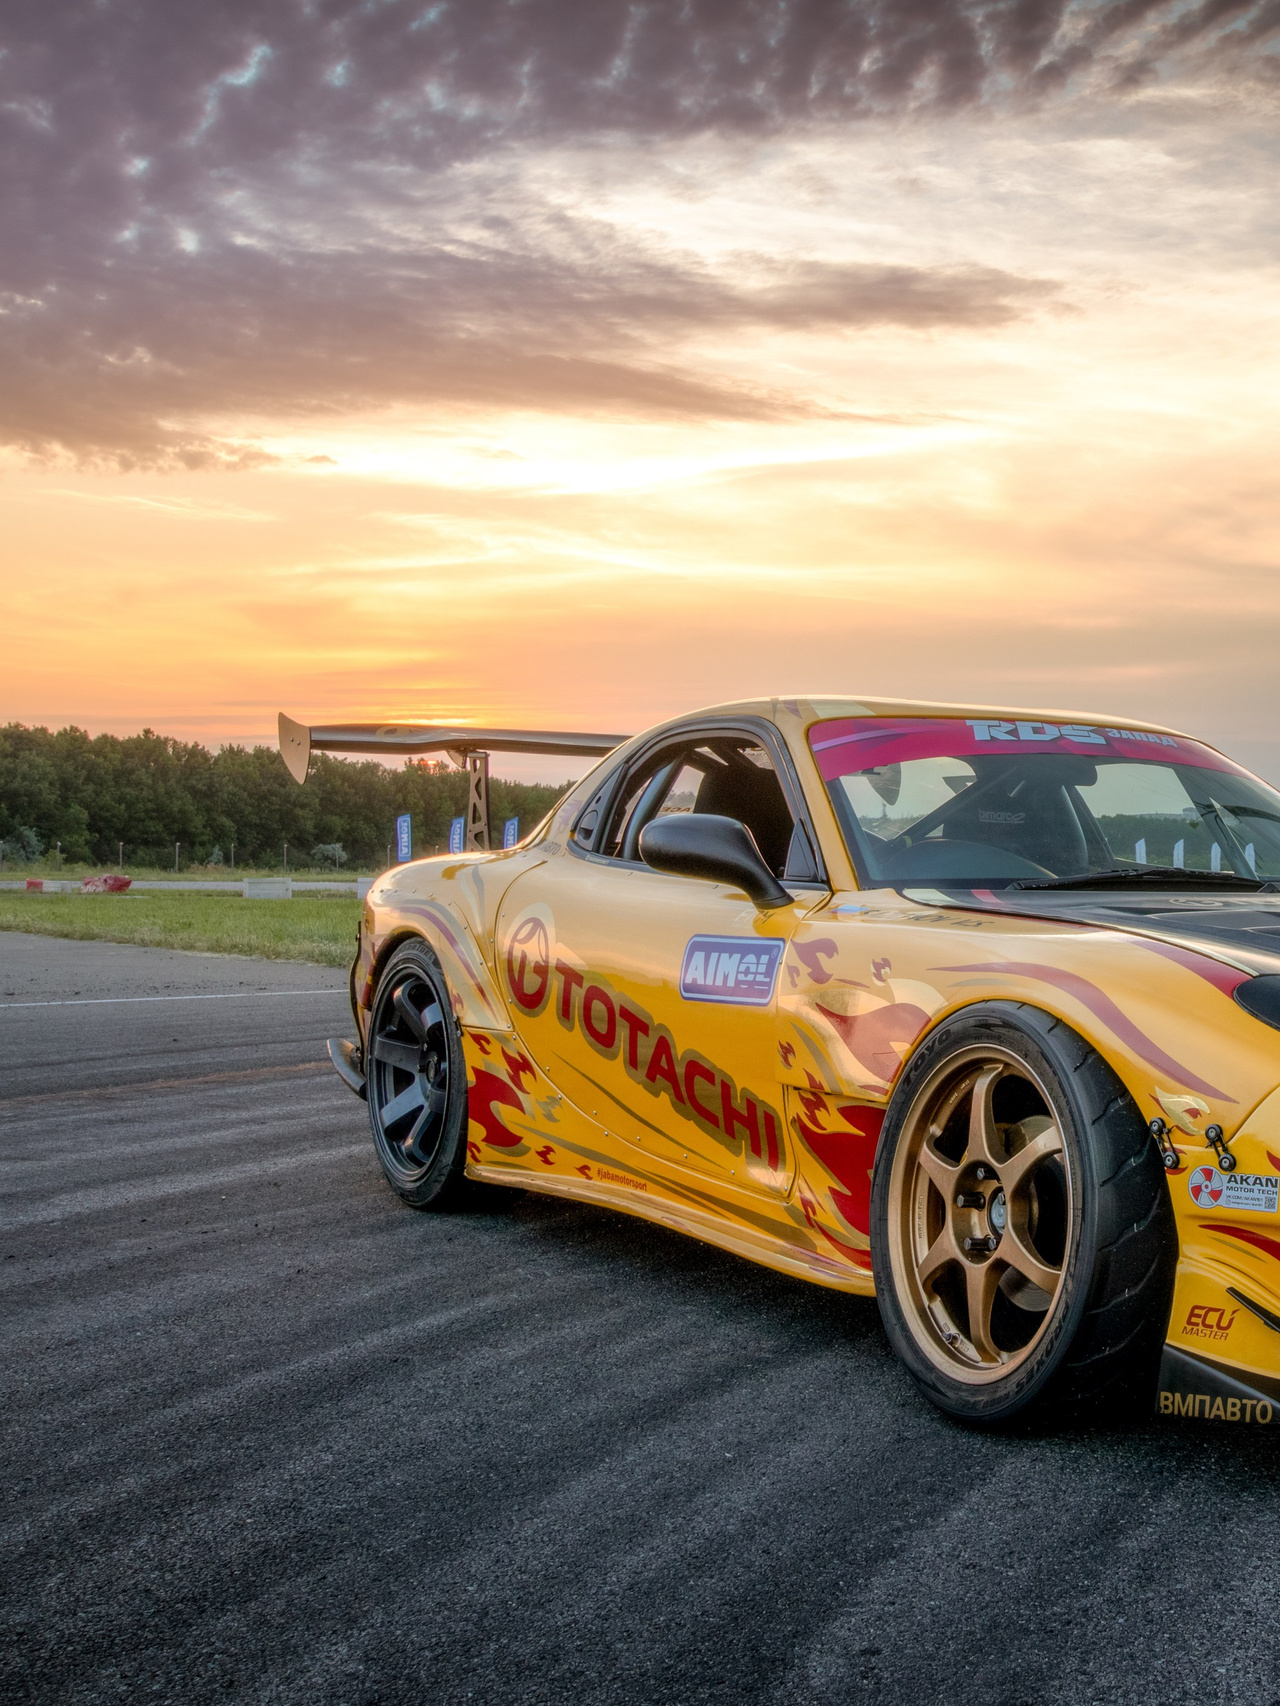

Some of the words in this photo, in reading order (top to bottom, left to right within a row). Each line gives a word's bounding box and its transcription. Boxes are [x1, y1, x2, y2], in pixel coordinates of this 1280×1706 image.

[965, 719, 1106, 745] RDS
[1107, 727, 1179, 748] ЗАПАД
[684, 951, 771, 989] AIMOL
[555, 957, 779, 1172] TOTACHI
[1226, 1186, 1255, 1194] MOTOR
[1256, 1188, 1278, 1196] TECH
[1227, 1174, 1279, 1189] AKAN
[1185, 1304, 1240, 1332] ECU
[1181, 1326, 1229, 1342] MASTER
[1160, 1390, 1274, 1425] ВМПАВТО
